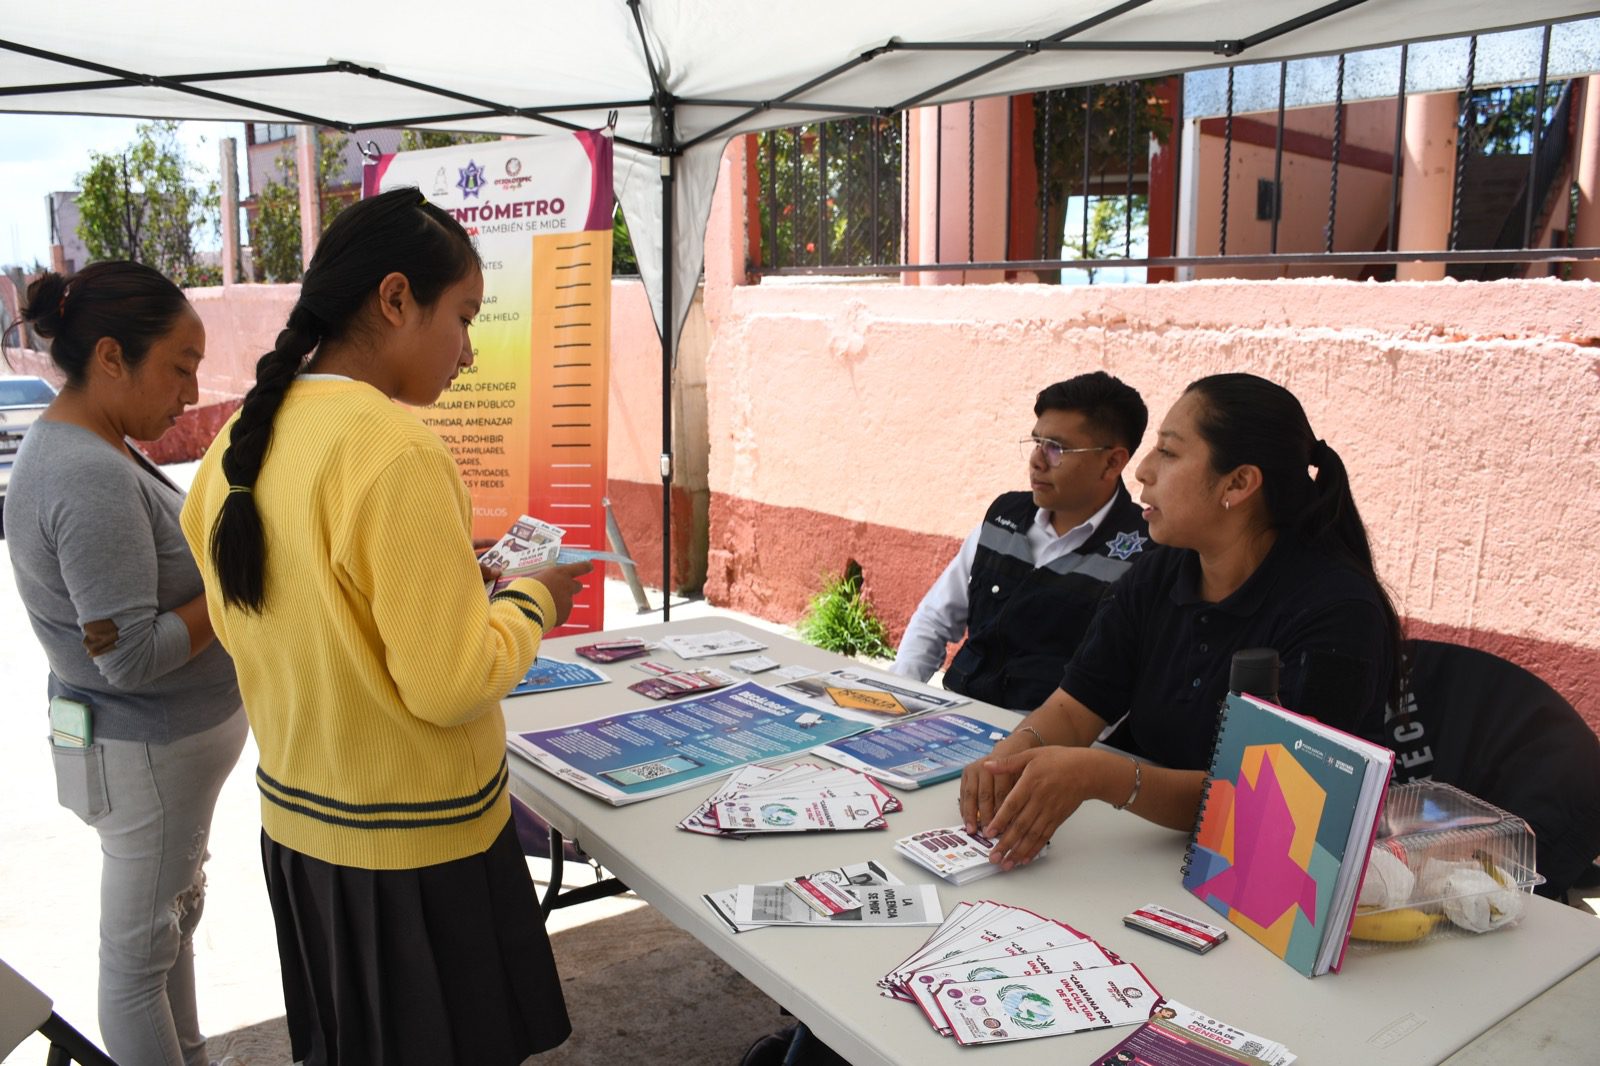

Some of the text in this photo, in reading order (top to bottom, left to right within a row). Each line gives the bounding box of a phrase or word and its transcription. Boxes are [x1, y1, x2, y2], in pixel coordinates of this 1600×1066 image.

[482, 221, 524, 235] TAMBIÉN
[526, 221, 538, 231] SE
[540, 218, 567, 229] MIDE
[493, 312, 520, 322] HIELO
[474, 382, 517, 391] OFENDER
[463, 401, 475, 409] EN
[477, 399, 516, 409] PÚBLICO
[465, 417, 513, 426] AMENAZAR
[461, 434, 504, 443] PROHIBIR
[480, 480, 505, 488] REDES
[868, 892, 881, 915] SE MIDE
[884, 888, 898, 919] VIOLENCIA
[902, 898, 913, 906] LA
[1027, 960, 1041, 974] UNA
[1056, 988, 1066, 998] DE
[1060, 978, 1073, 992] UNA
[1071, 989, 1096, 1022] CULTURA
[1096, 1008, 1111, 1025] POR
[1192, 1020, 1223, 1036] POLICÍA
[1223, 1033, 1236, 1041] DE
